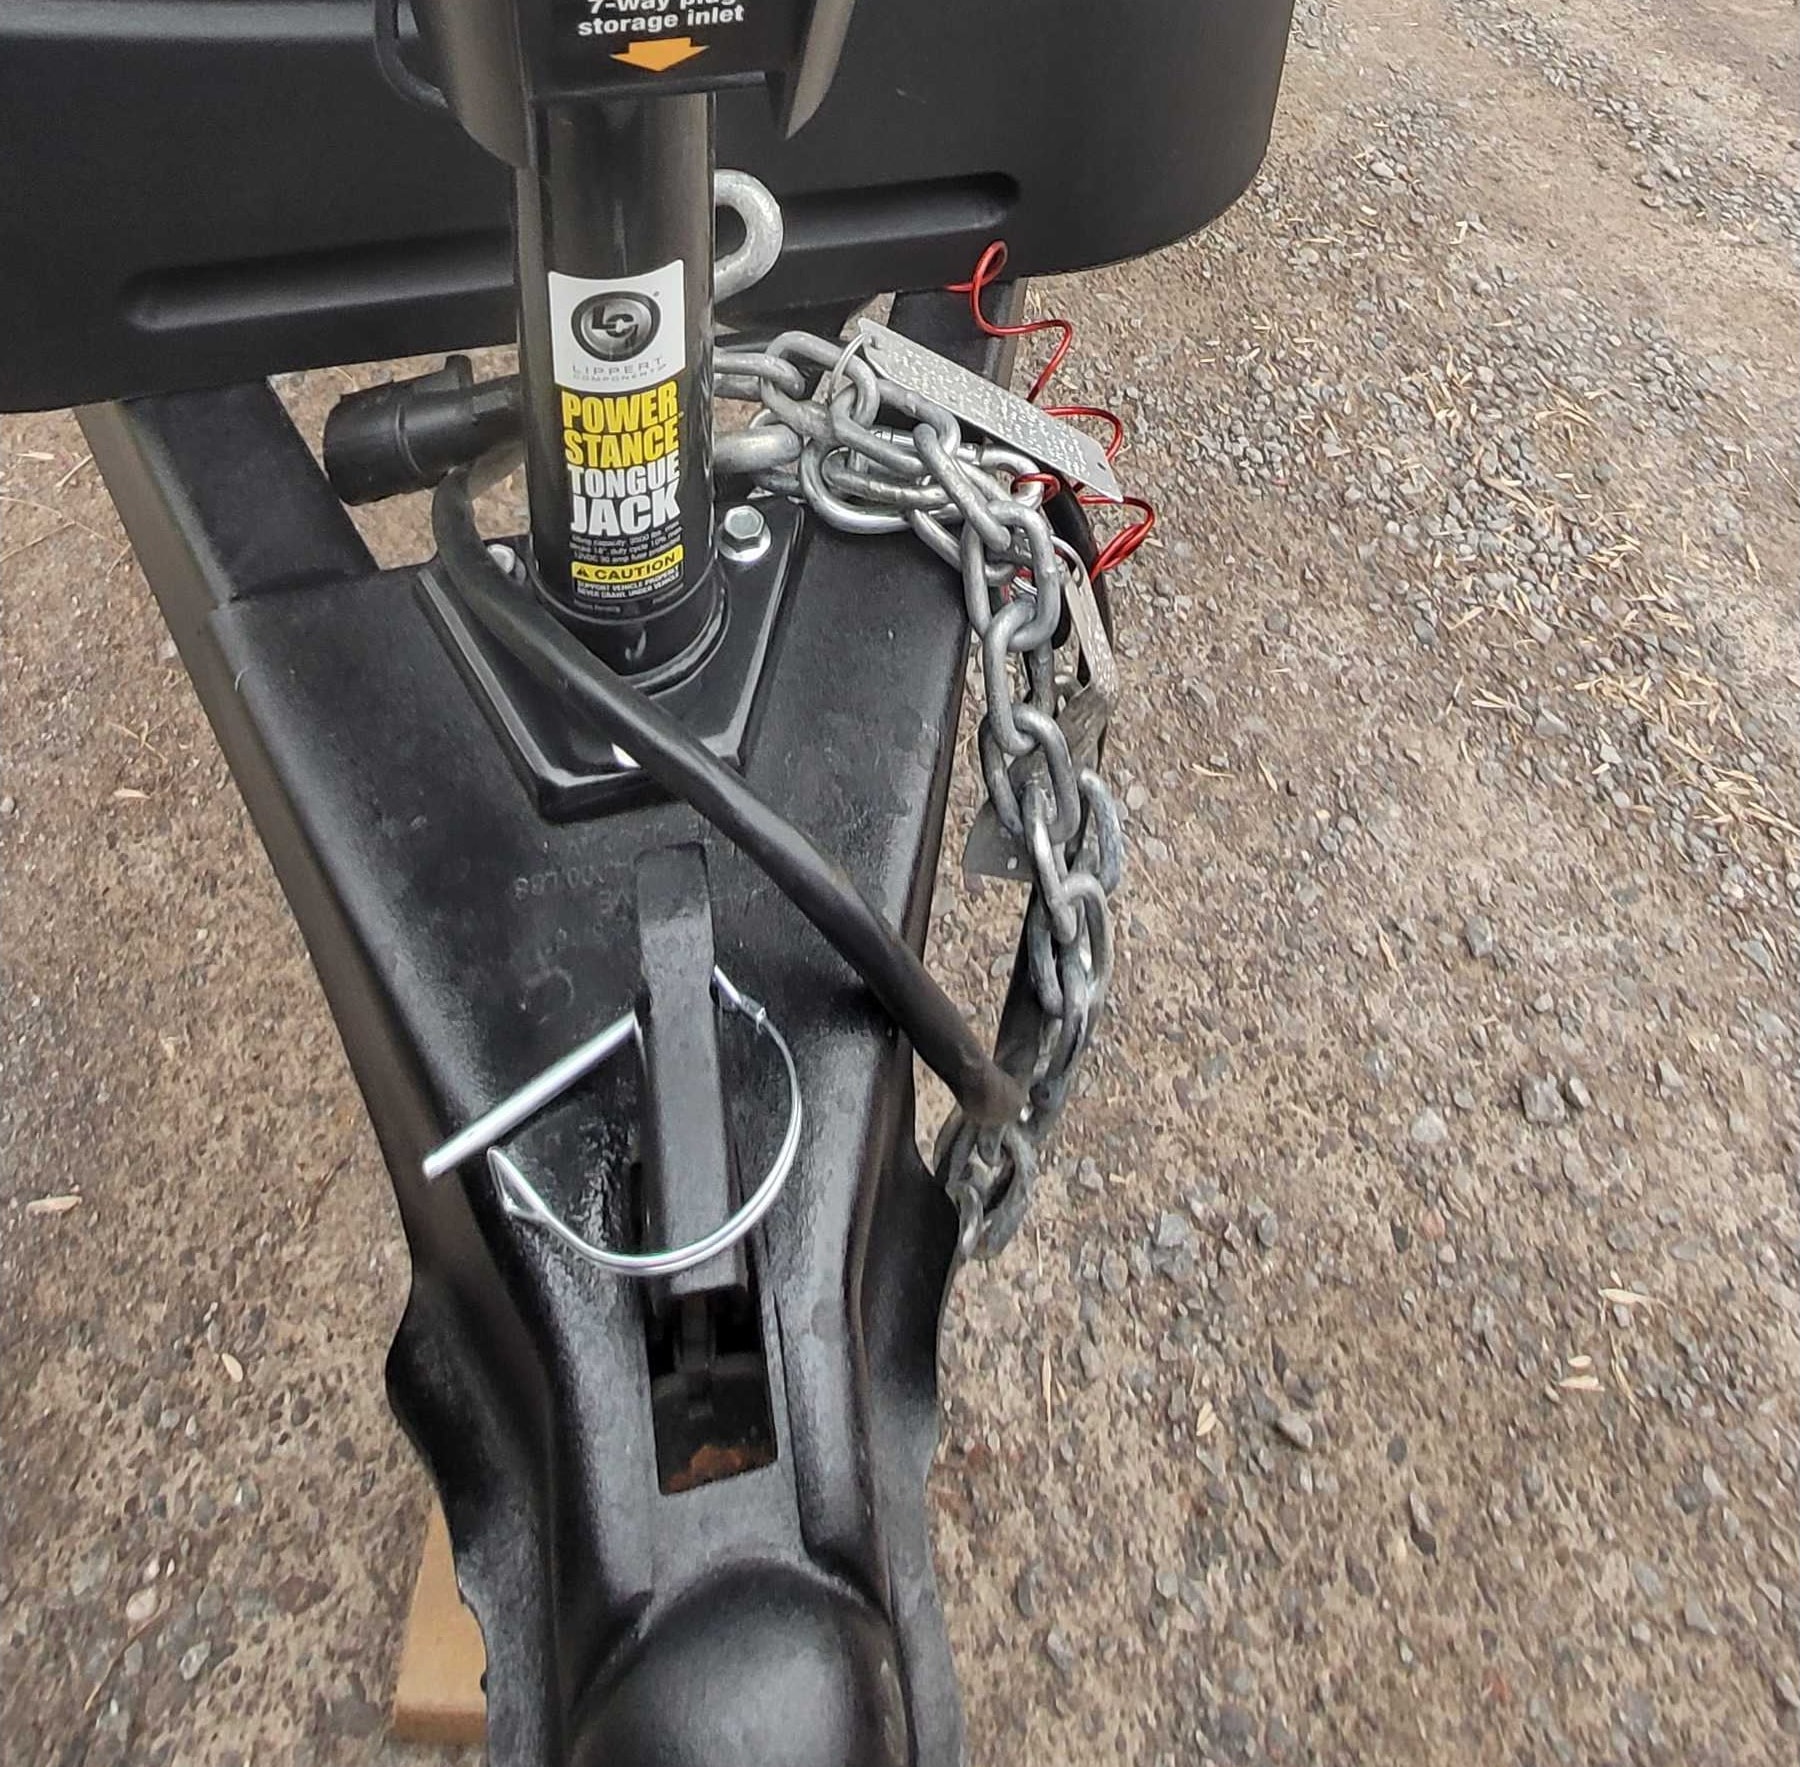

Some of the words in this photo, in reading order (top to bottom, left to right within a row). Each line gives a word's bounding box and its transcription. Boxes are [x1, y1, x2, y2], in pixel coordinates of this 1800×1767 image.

[577, 10, 679, 36] storage
[687, 4, 745, 27] inlet
[572, 357, 663, 376] LIPPERT
[561, 380, 678, 434] POWER
[563, 415, 680, 469] STANCE
[567, 449, 681, 498] TONGUE
[570, 478, 681, 537] JACK
[594, 554, 676, 580] CAUTION
